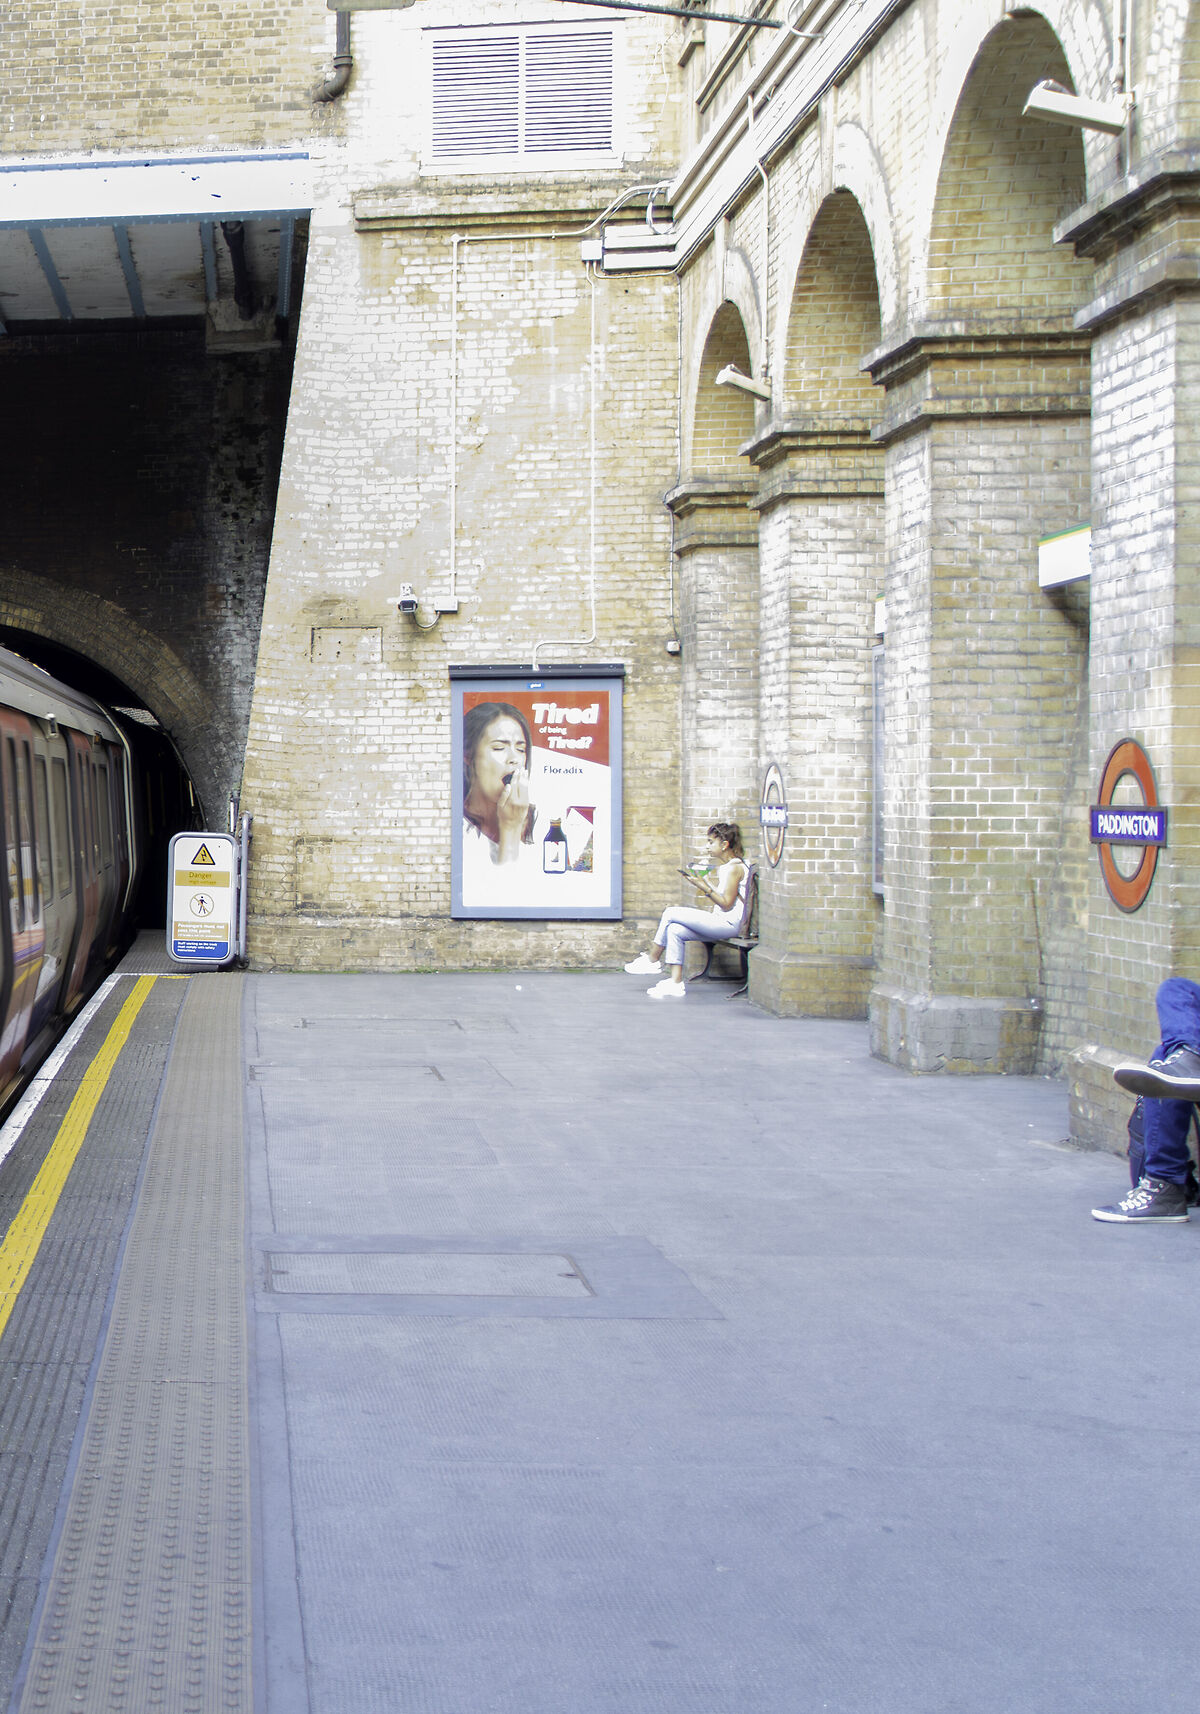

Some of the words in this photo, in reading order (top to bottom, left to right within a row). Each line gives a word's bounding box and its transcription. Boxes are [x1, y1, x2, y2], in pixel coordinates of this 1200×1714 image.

[531, 703, 599, 724] Tired
[547, 736, 593, 749] Tired?
[543, 766, 583, 774] Floradix
[1097, 814, 1158, 836] PADDINGTON
[189, 872, 212, 880] Danger
